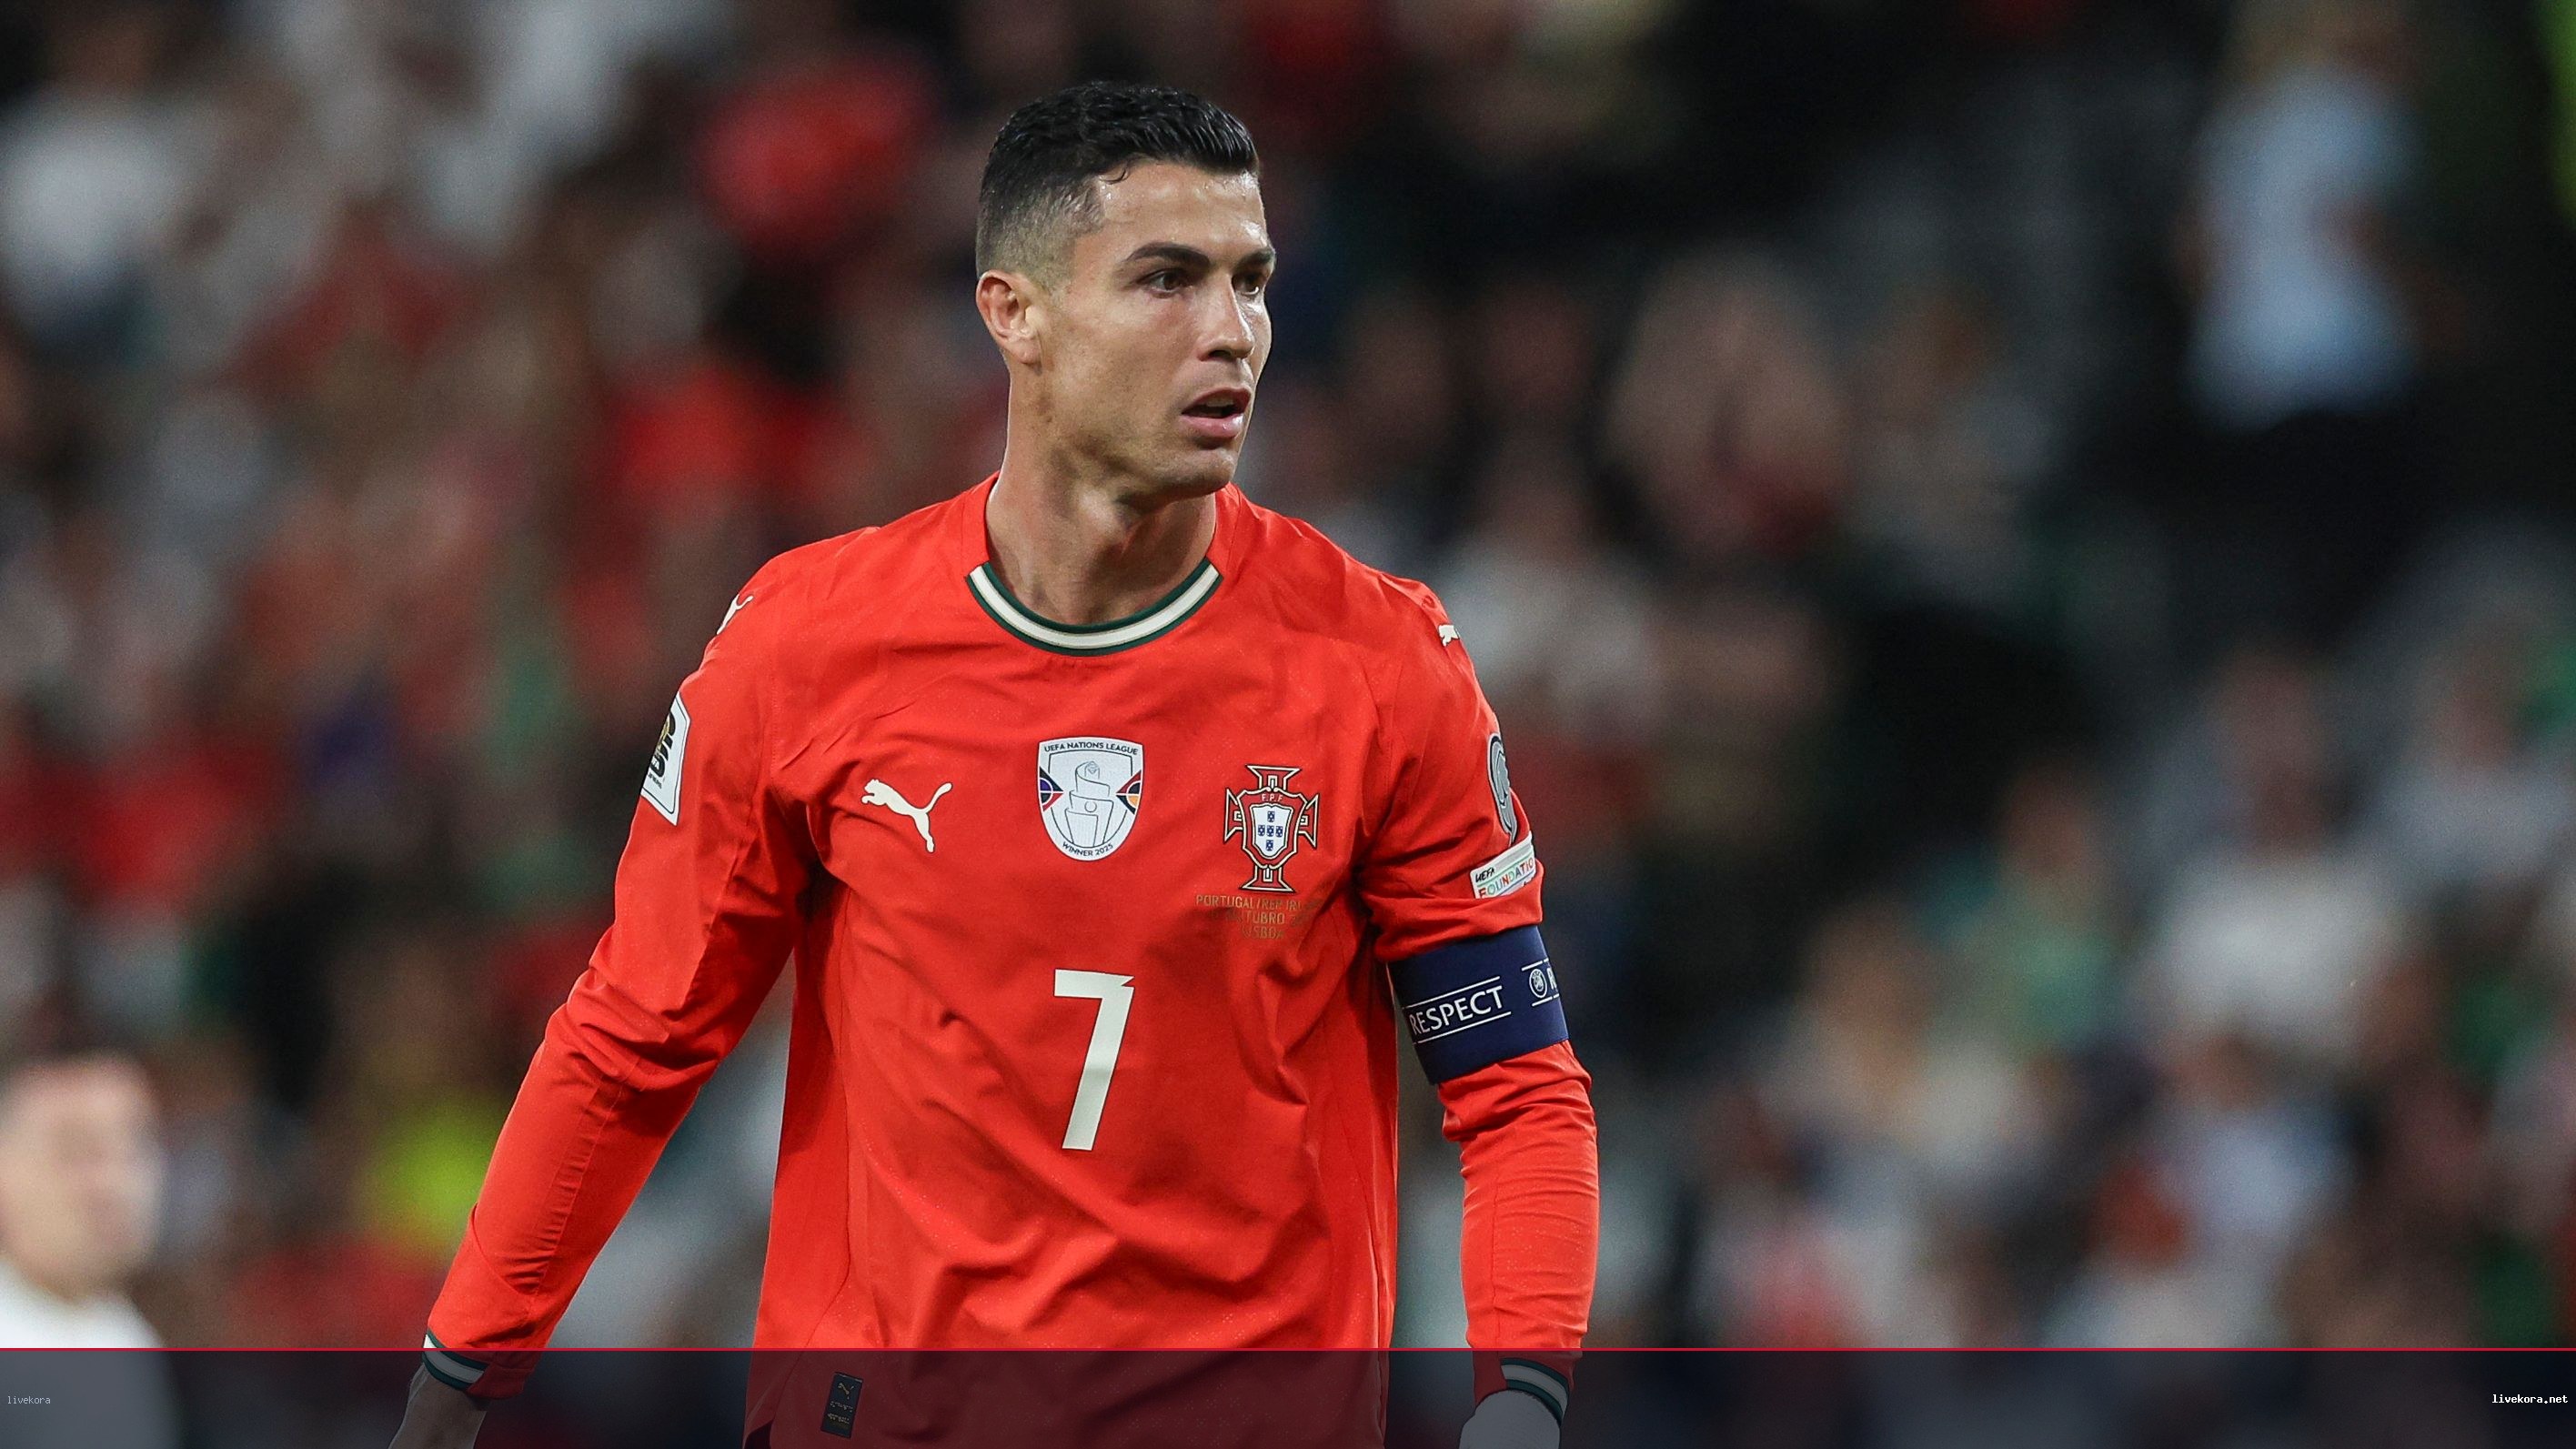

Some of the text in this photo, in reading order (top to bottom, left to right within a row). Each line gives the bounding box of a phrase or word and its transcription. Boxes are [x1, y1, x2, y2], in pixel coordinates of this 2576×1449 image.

[1044, 741, 1139, 755] UEFA NATIONS LEAGUE
[1062, 841, 1114, 857] WINNER 2025
[1475, 867, 1494, 882] UEFA
[1409, 985, 1503, 1036] RESPECT
[1053, 969, 1135, 1152] 7
